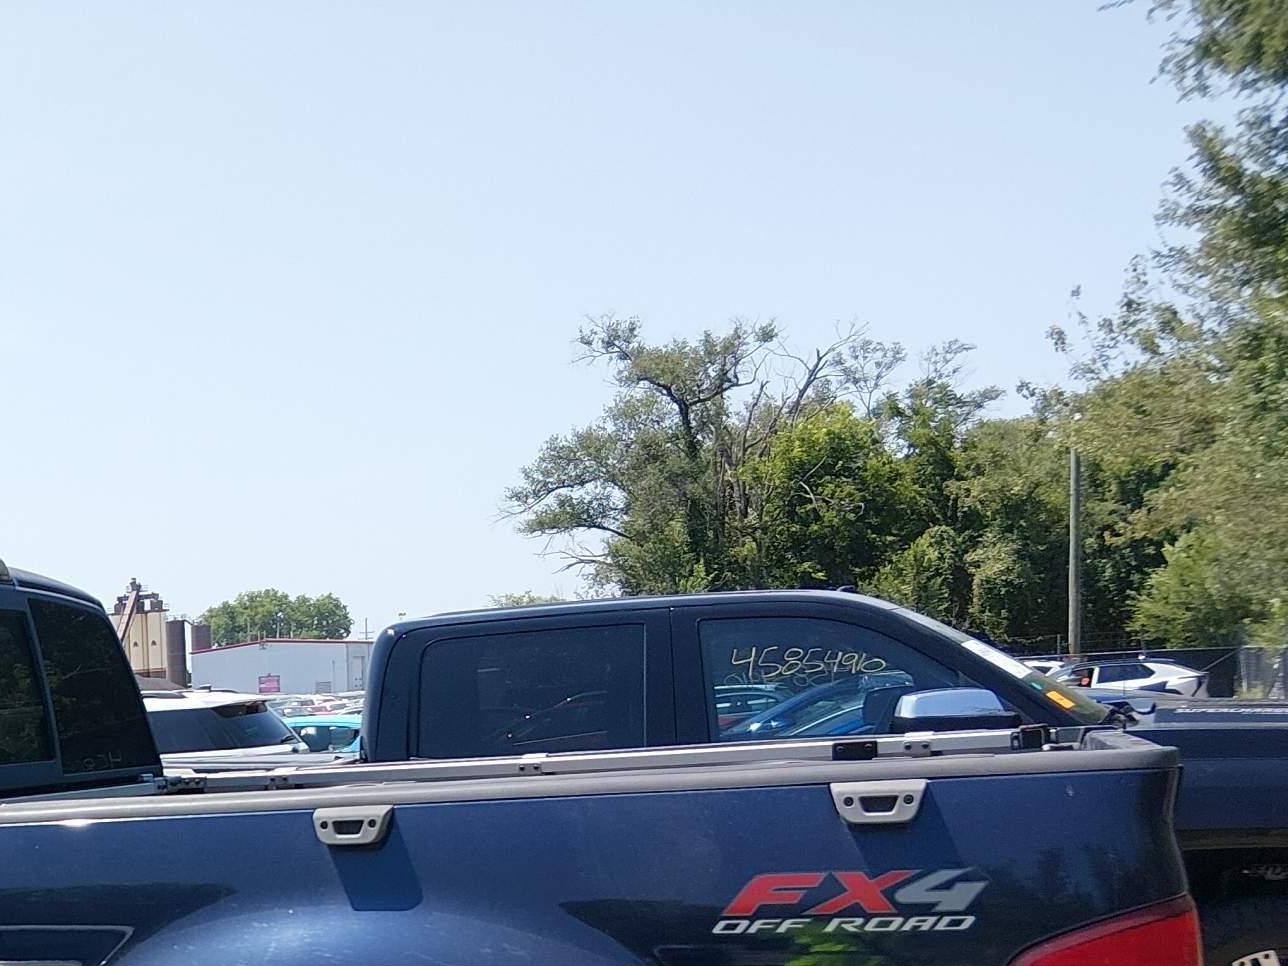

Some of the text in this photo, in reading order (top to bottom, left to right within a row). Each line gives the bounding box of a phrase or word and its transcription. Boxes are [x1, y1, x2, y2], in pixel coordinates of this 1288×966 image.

[722, 868, 990, 916] FX4
[712, 915, 977, 935] OFF ROAD
